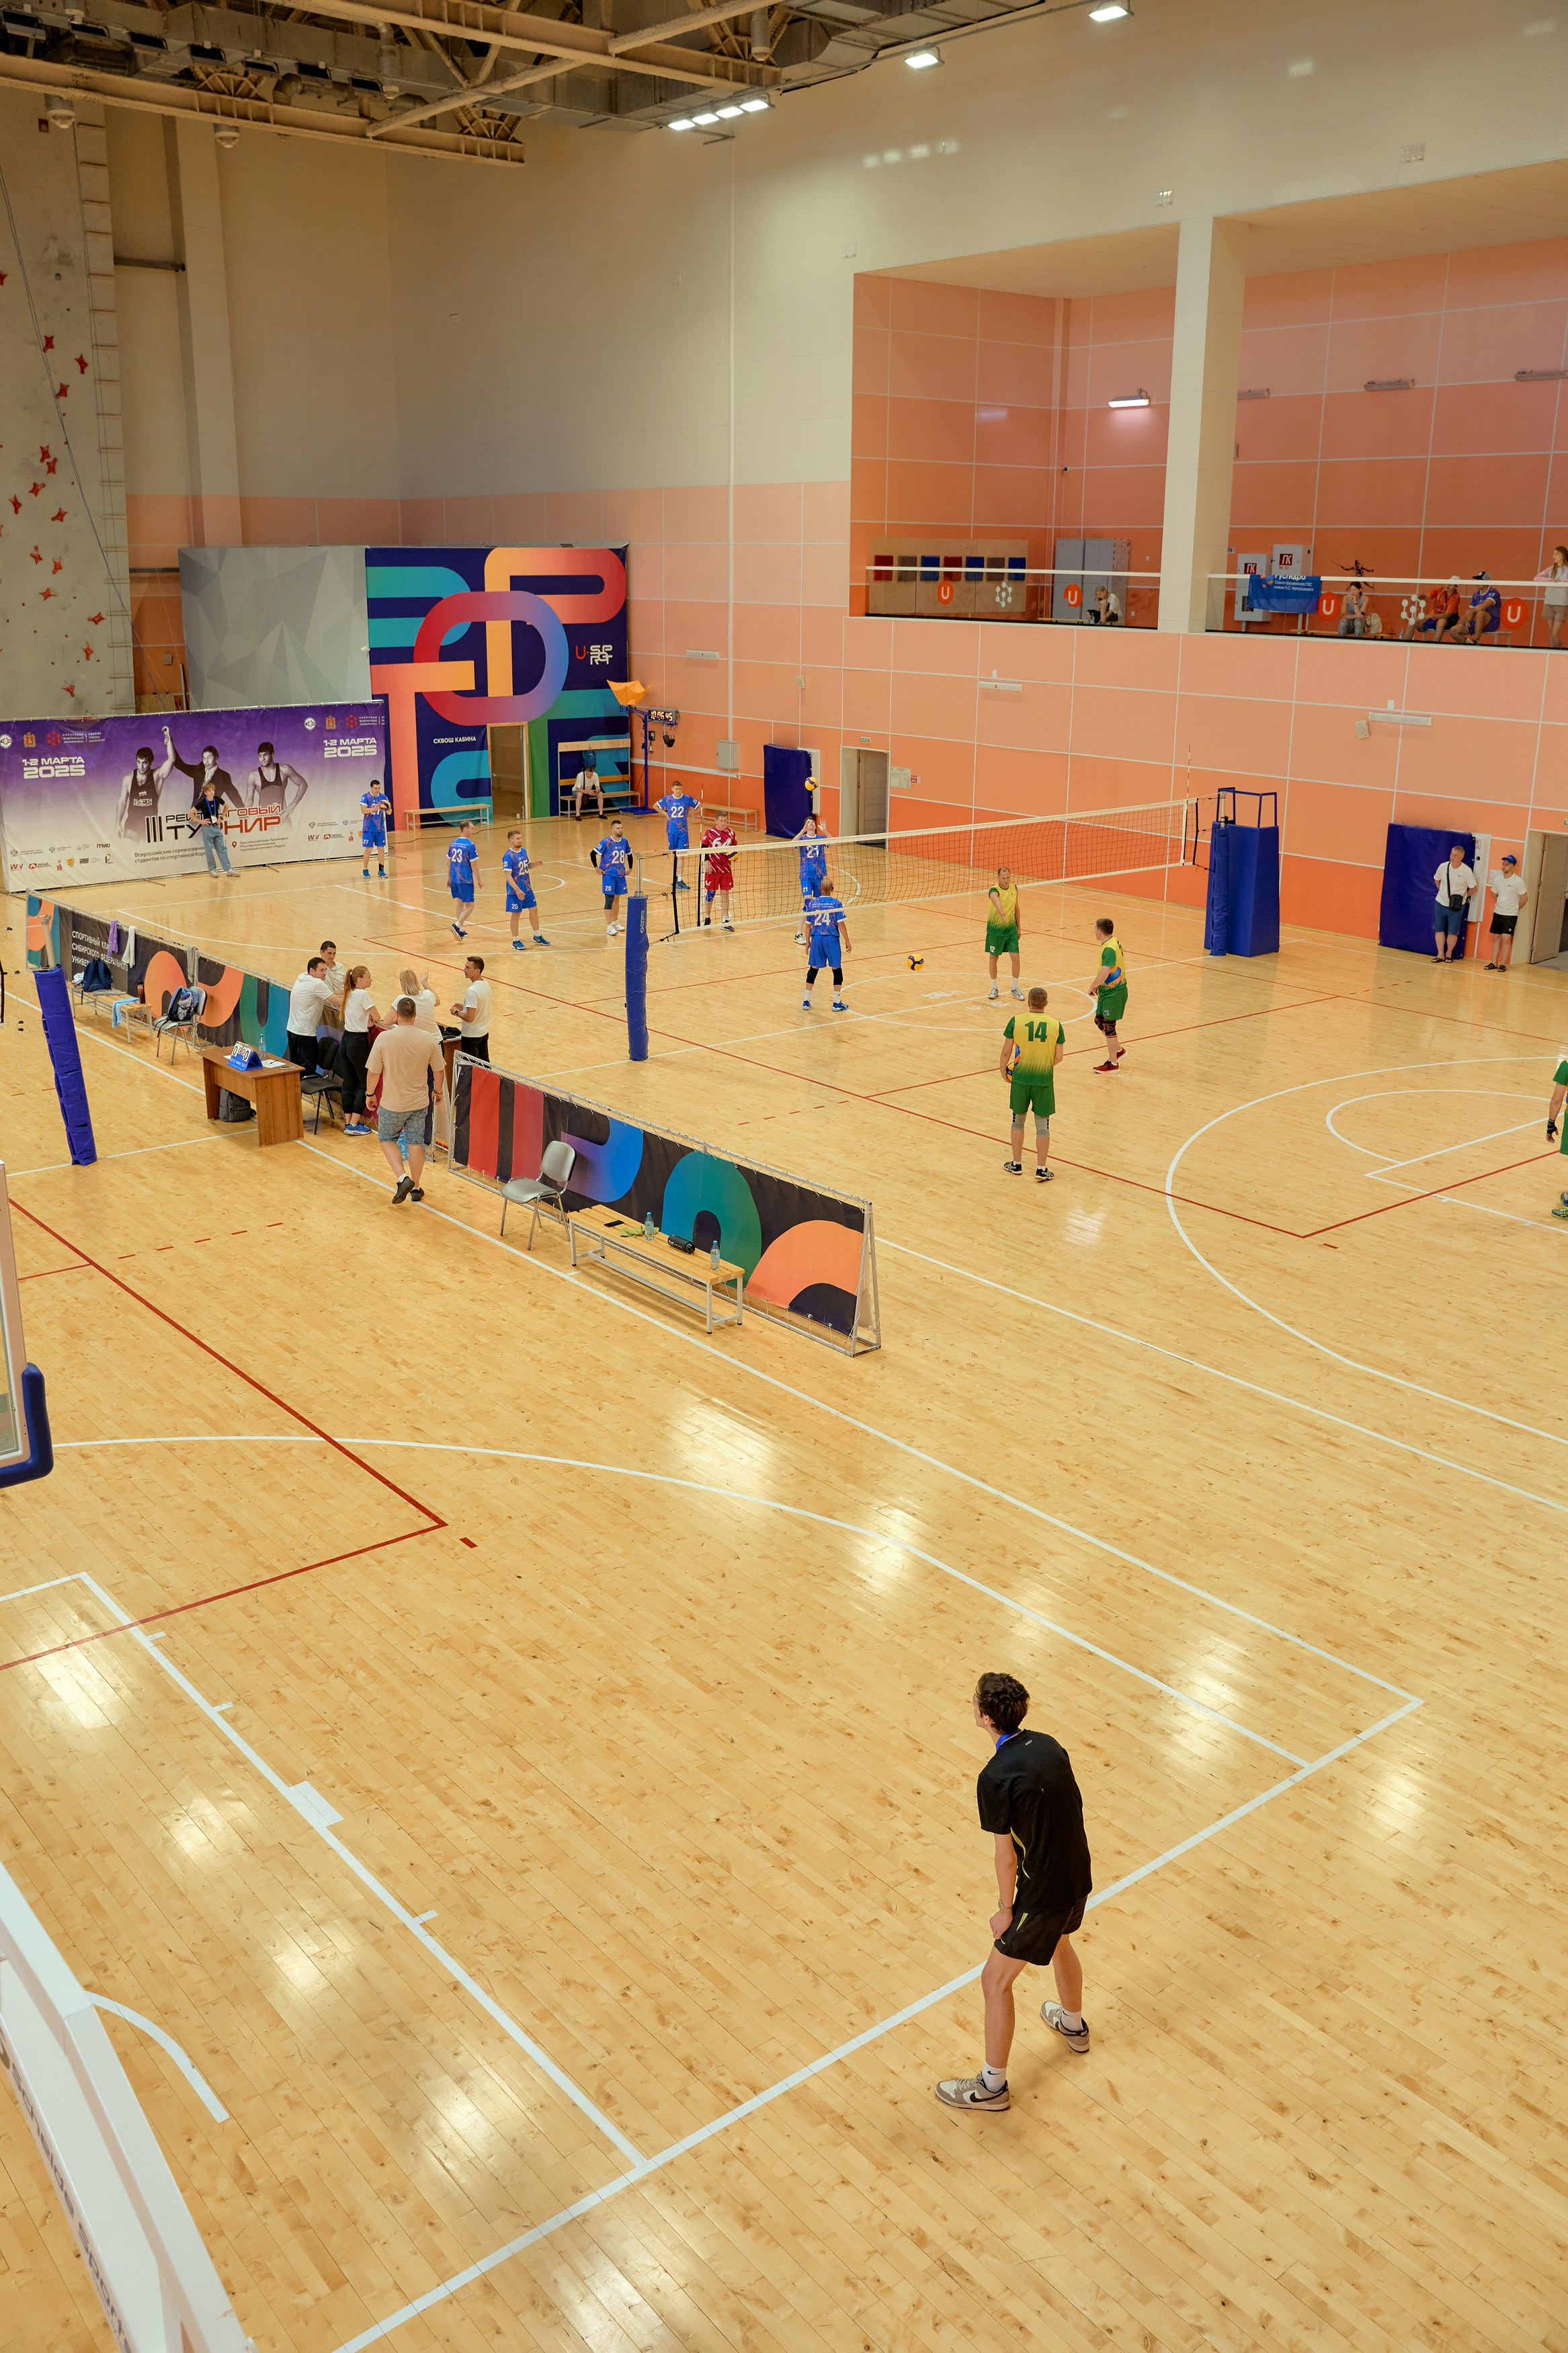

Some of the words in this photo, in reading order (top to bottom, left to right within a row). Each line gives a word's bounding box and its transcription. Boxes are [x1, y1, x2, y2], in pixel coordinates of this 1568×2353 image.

[339, 737, 377, 746] МАРТА
[324, 745, 377, 758] 2025
[22, 758, 38, 766] 1-2
[41, 756, 85, 765] МАРТА
[24, 765, 85, 779] 2025
[671, 806, 684, 817] 22
[166, 816, 281, 840] ТУНИР
[135, 850, 171, 858] Всероссийские
[452, 848, 462, 863] 23
[612, 850, 625, 863] 28
[807, 845, 819, 858] 21
[519, 859, 529, 875] 25
[815, 910, 831, 925] 24
[72, 930, 100, 947] СПОРТИВНЫЙ
[72, 943, 99, 958] СИБИРСКОГО
[100, 953, 128, 971] ФЕДЕРАЛЬНОГО
[1025, 1021, 1047, 1042] 14
[12, 2062, 74, 2219] Schelde
